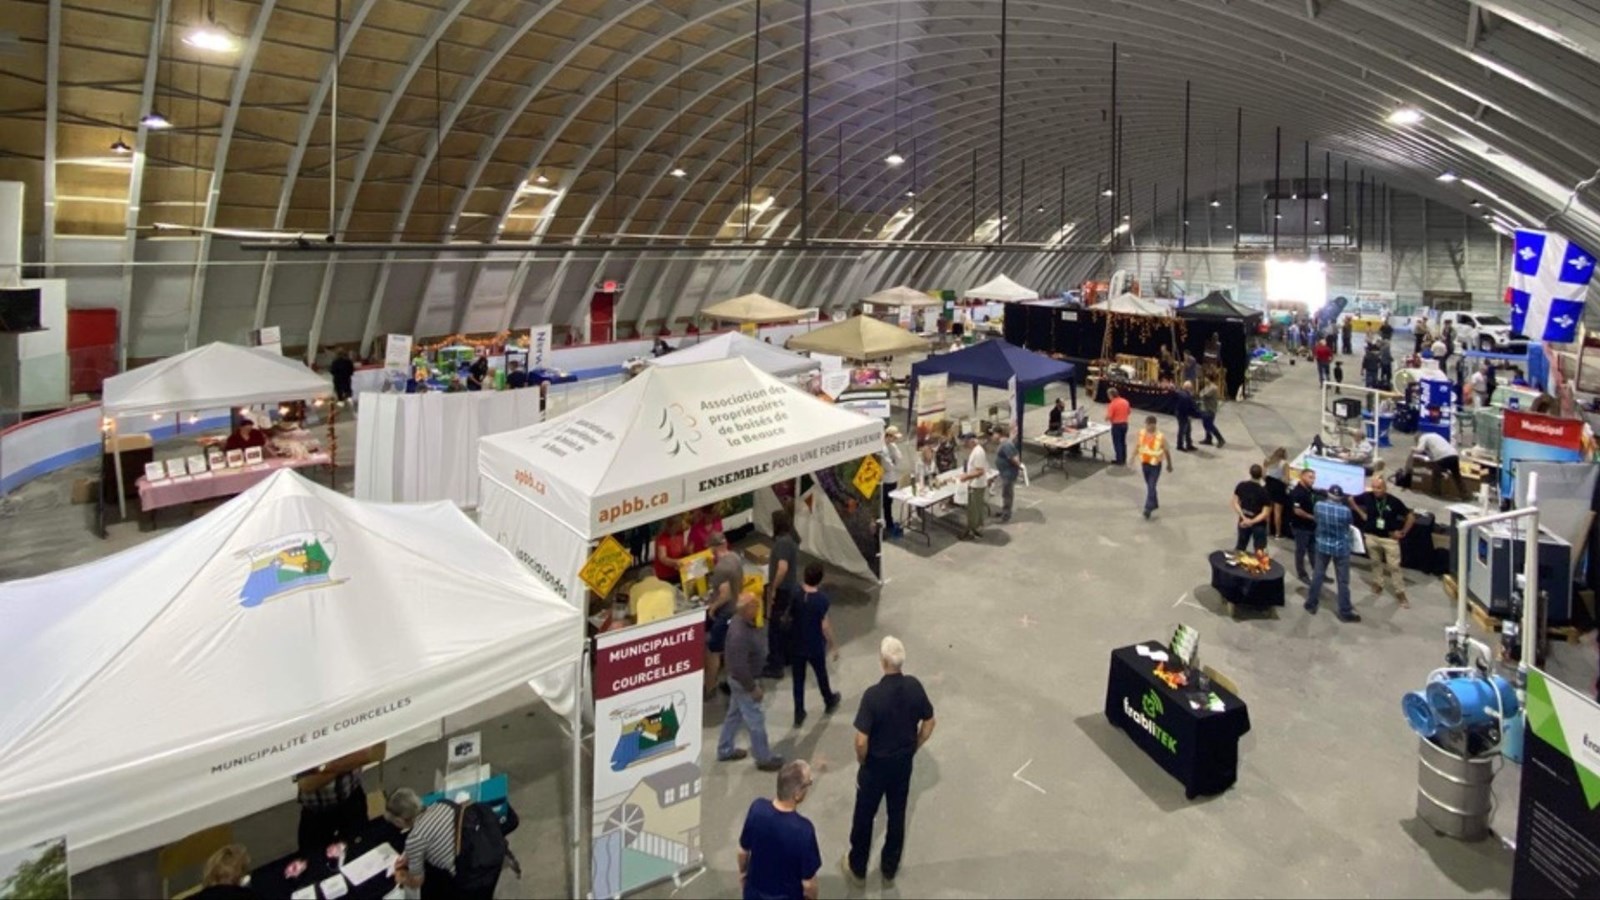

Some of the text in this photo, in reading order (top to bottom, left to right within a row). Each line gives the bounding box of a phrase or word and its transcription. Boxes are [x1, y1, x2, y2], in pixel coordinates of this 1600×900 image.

[700, 385, 788, 411] Association des
[708, 399, 785, 426] propriétaires
[718, 411, 789, 436] de boisés de
[727, 426, 786, 447] la Beauce
[1520, 419, 1564, 436] Municipal
[699, 431, 882, 492] ENSEMBLE POUR UNE FORÊT D'AVENIR
[514, 469, 546, 496] apbb.ca
[598, 491, 670, 523] apbb.ca
[609, 627, 696, 663] MUNICIPALITÉ
[644, 653, 661, 668] DE
[612, 660, 691, 692] COURCELLES
[312, 726, 330, 741] DE
[333, 696, 412, 732] COURCELLES
